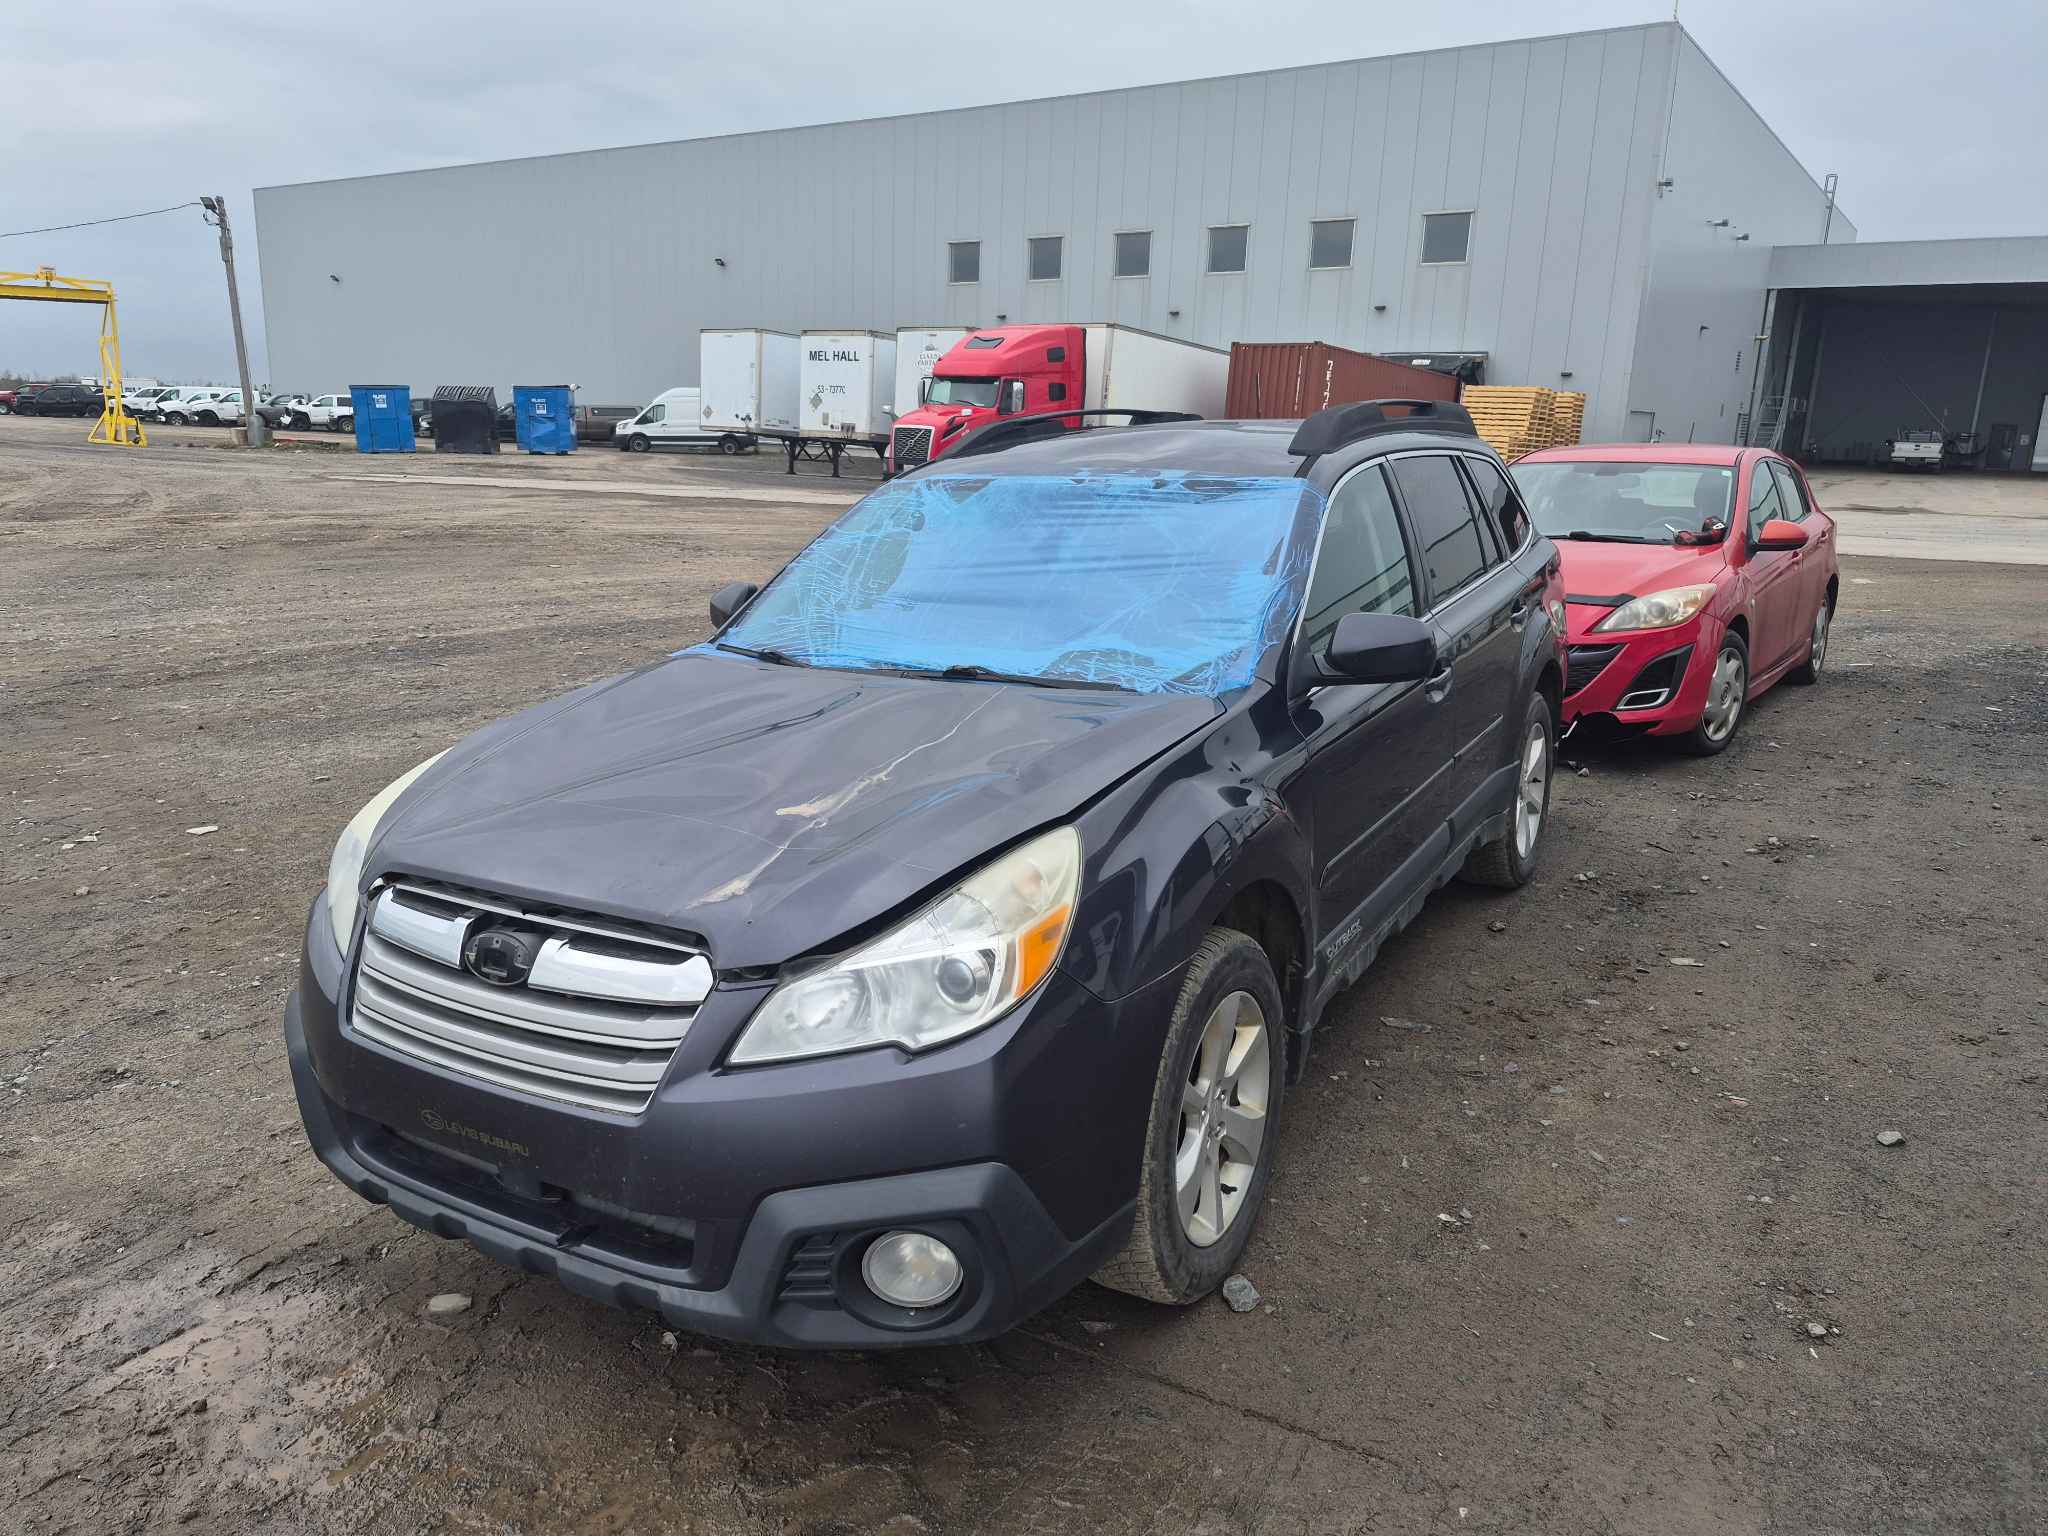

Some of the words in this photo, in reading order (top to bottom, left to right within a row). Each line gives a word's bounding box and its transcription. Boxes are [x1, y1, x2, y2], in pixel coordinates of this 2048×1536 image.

[809, 350, 830, 361] MEL
[833, 350, 860, 361] HALL
[480, 1132, 529, 1157] SUBARU
